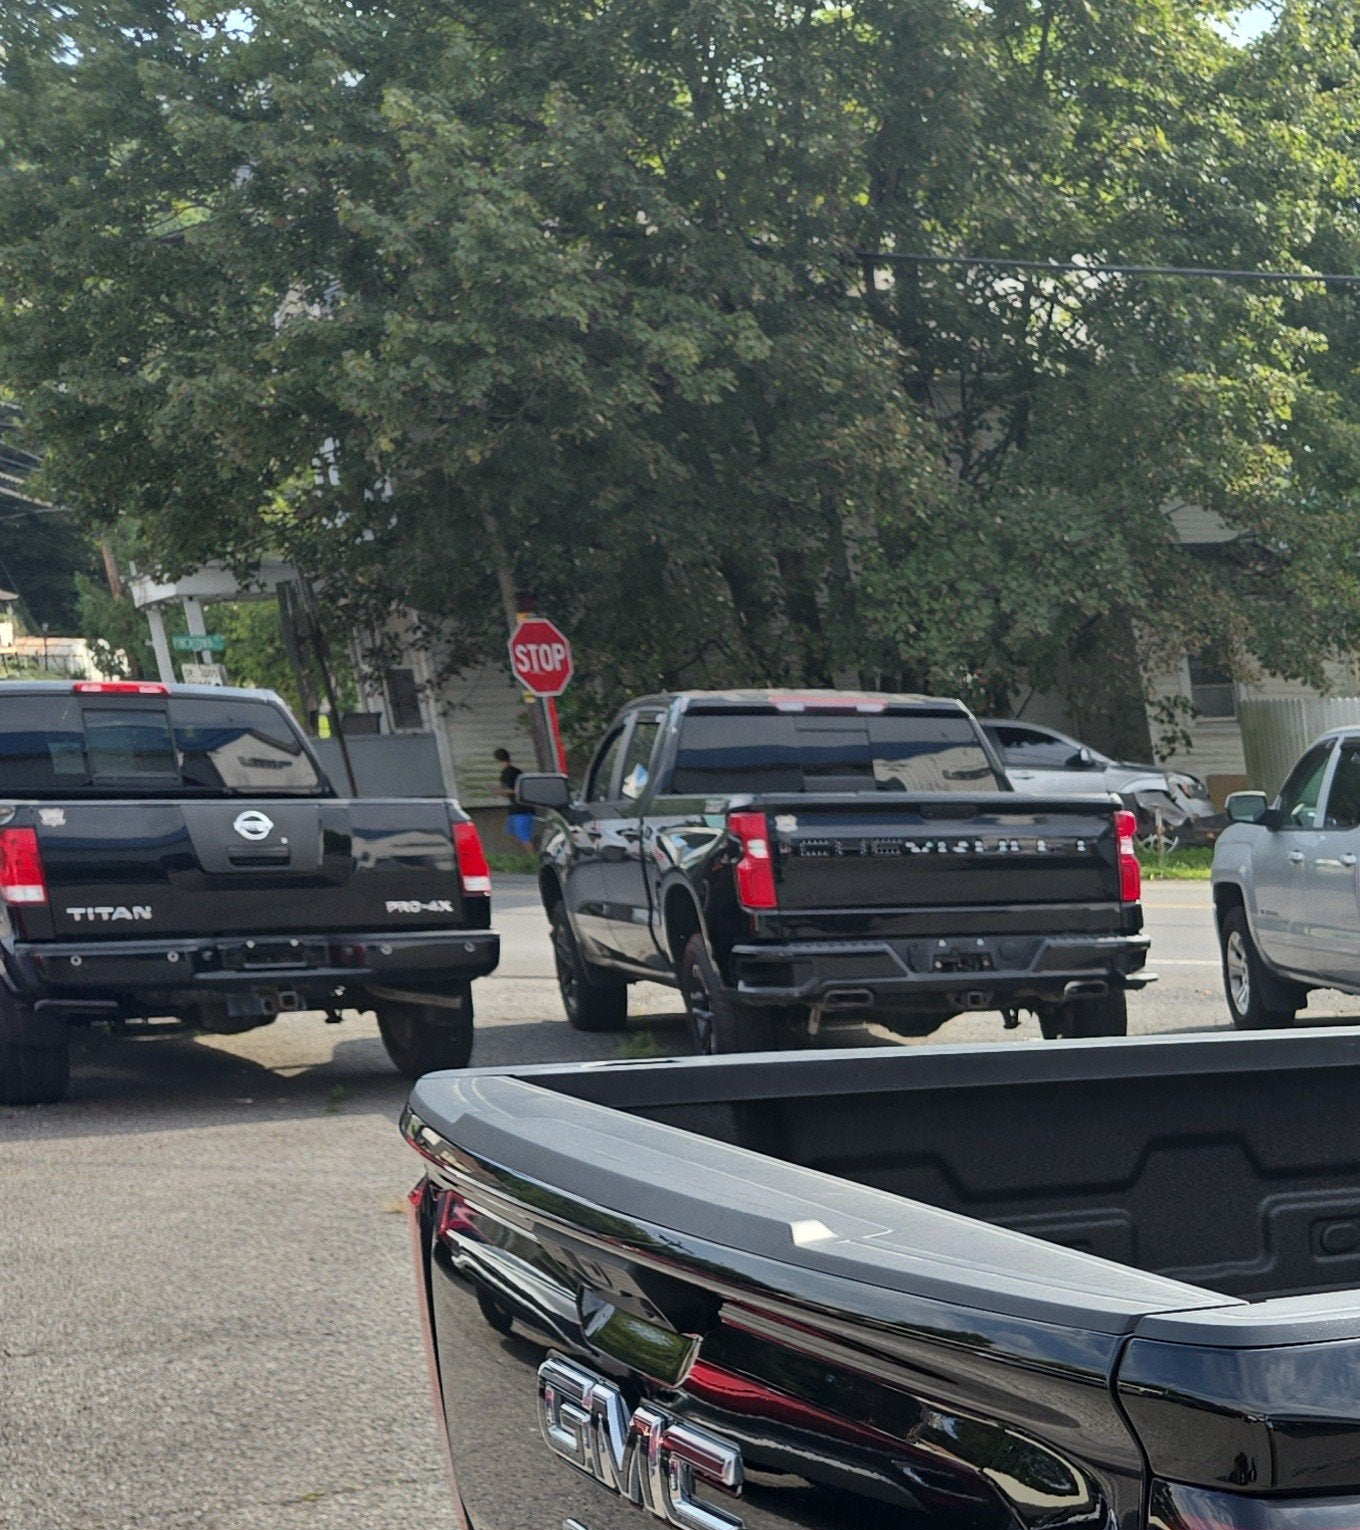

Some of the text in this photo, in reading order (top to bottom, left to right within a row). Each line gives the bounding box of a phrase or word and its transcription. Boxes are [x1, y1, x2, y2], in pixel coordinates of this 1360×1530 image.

[515, 643, 566, 673] STOP
[66, 905, 153, 922] TITAN
[384, 899, 455, 914] PRO-4X
